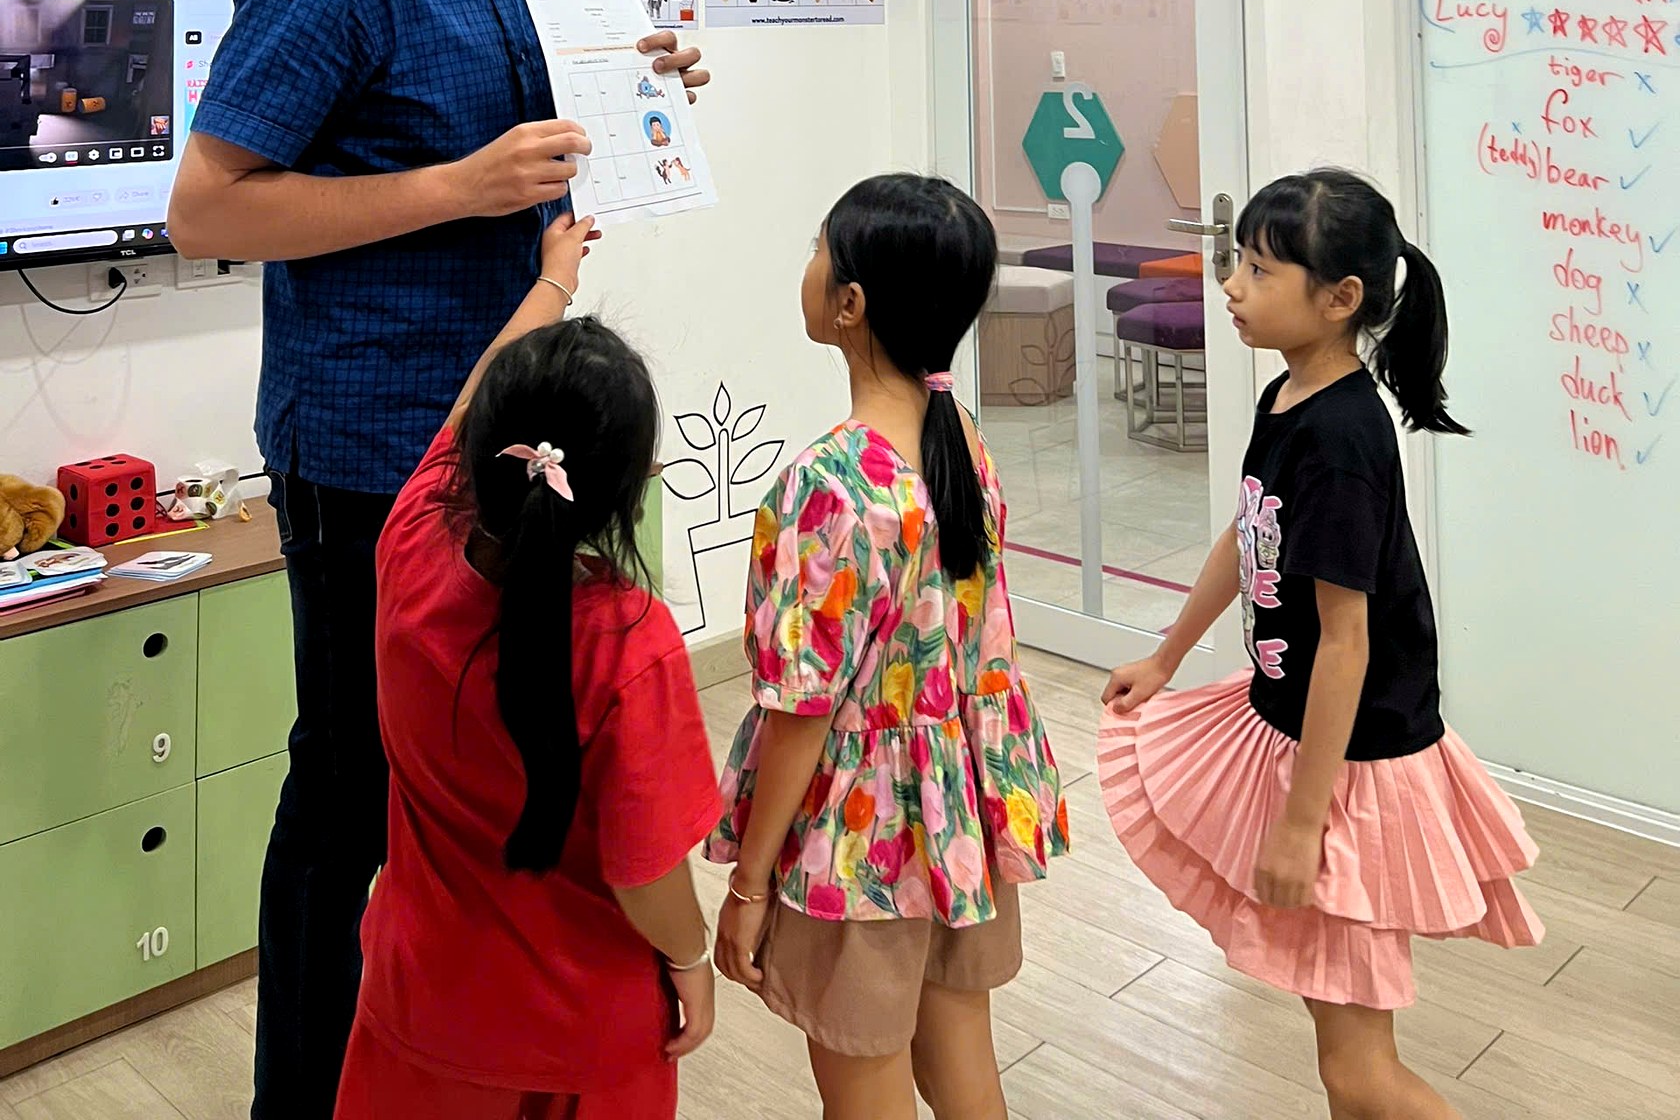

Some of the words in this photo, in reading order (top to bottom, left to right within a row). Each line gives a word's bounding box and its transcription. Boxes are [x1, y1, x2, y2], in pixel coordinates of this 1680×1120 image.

[751, 15, 844, 26] www.teachyourmonstertoread.com
[1549, 54, 1624, 88] tiger
[1541, 89, 1599, 139] fox
[1543, 207, 1645, 273] monkey
[1553, 247, 1603, 316] dog
[1549, 306, 1630, 370] sheep
[1560, 356, 1633, 422] duck
[151, 731, 172, 764] 9
[136, 926, 169, 962] 10
